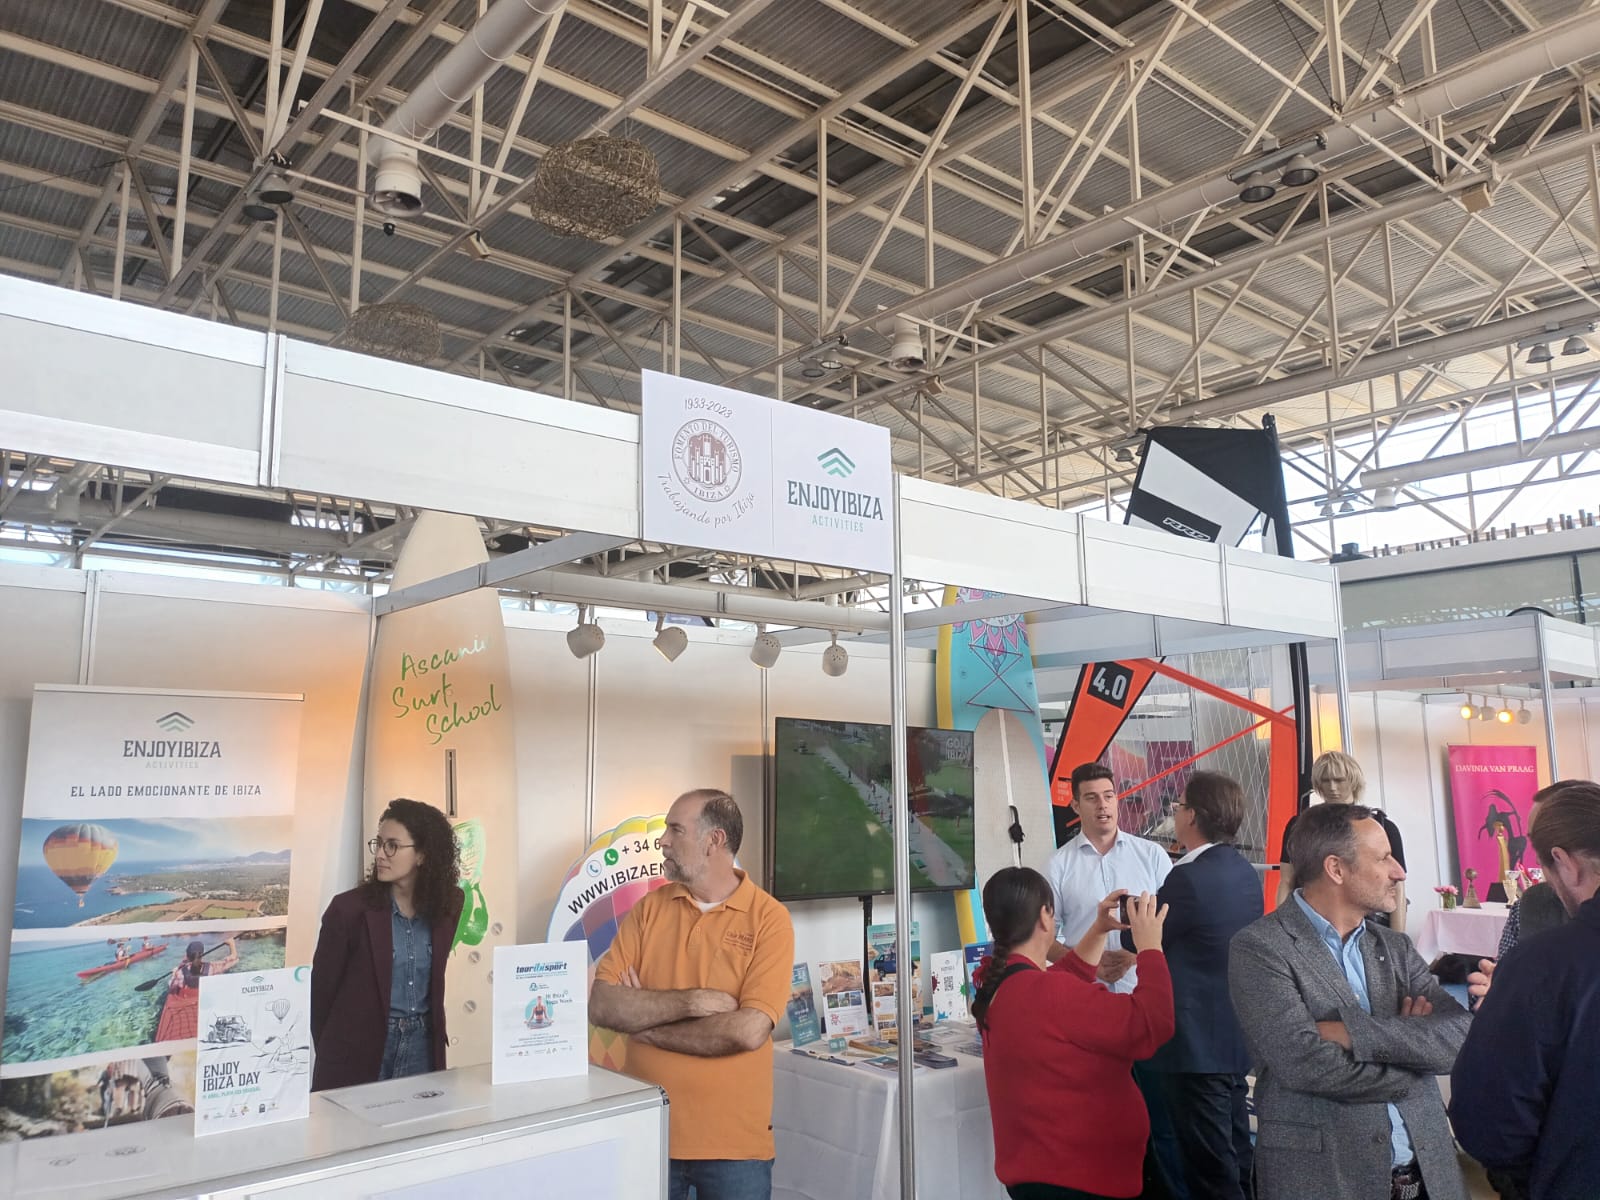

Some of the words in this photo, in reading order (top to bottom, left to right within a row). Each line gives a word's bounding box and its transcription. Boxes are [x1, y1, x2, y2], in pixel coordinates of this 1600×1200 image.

[684, 397, 733, 419] 1933-2023
[674, 421, 701, 460] FOMENTO
[701, 421, 721, 435] DEL
[718, 426, 740, 474] TURISMO
[657, 473, 711, 524] Trabajando
[714, 513, 733, 529] por
[693, 486, 724, 500] IBIZA
[786, 479, 884, 521] ENJOYIBIZA
[811, 514, 865, 533] ACTIVITIES
[1092, 666, 1127, 700] 4.0
[426, 683, 502, 745] School
[123, 740, 222, 758] ENJOYIBIZA
[145, 761, 200, 769] ACTIVITIES
[1455, 764, 1488, 773] DAVINIA
[1489, 765, 1507, 773] VAN
[1507, 765, 1534, 773] PRAAG
[70, 786, 85, 797] EL
[90, 785, 122, 797] LADO
[127, 785, 210, 797] EMOCIONANTE
[214, 784, 229, 796] DE
[232, 784, 262, 796] IBIZA
[633, 838, 650, 853] 34
[203, 1060, 241, 1079] ENJOY
[203, 1075, 234, 1092] IBIZA
[238, 1071, 261, 1087] DAY
